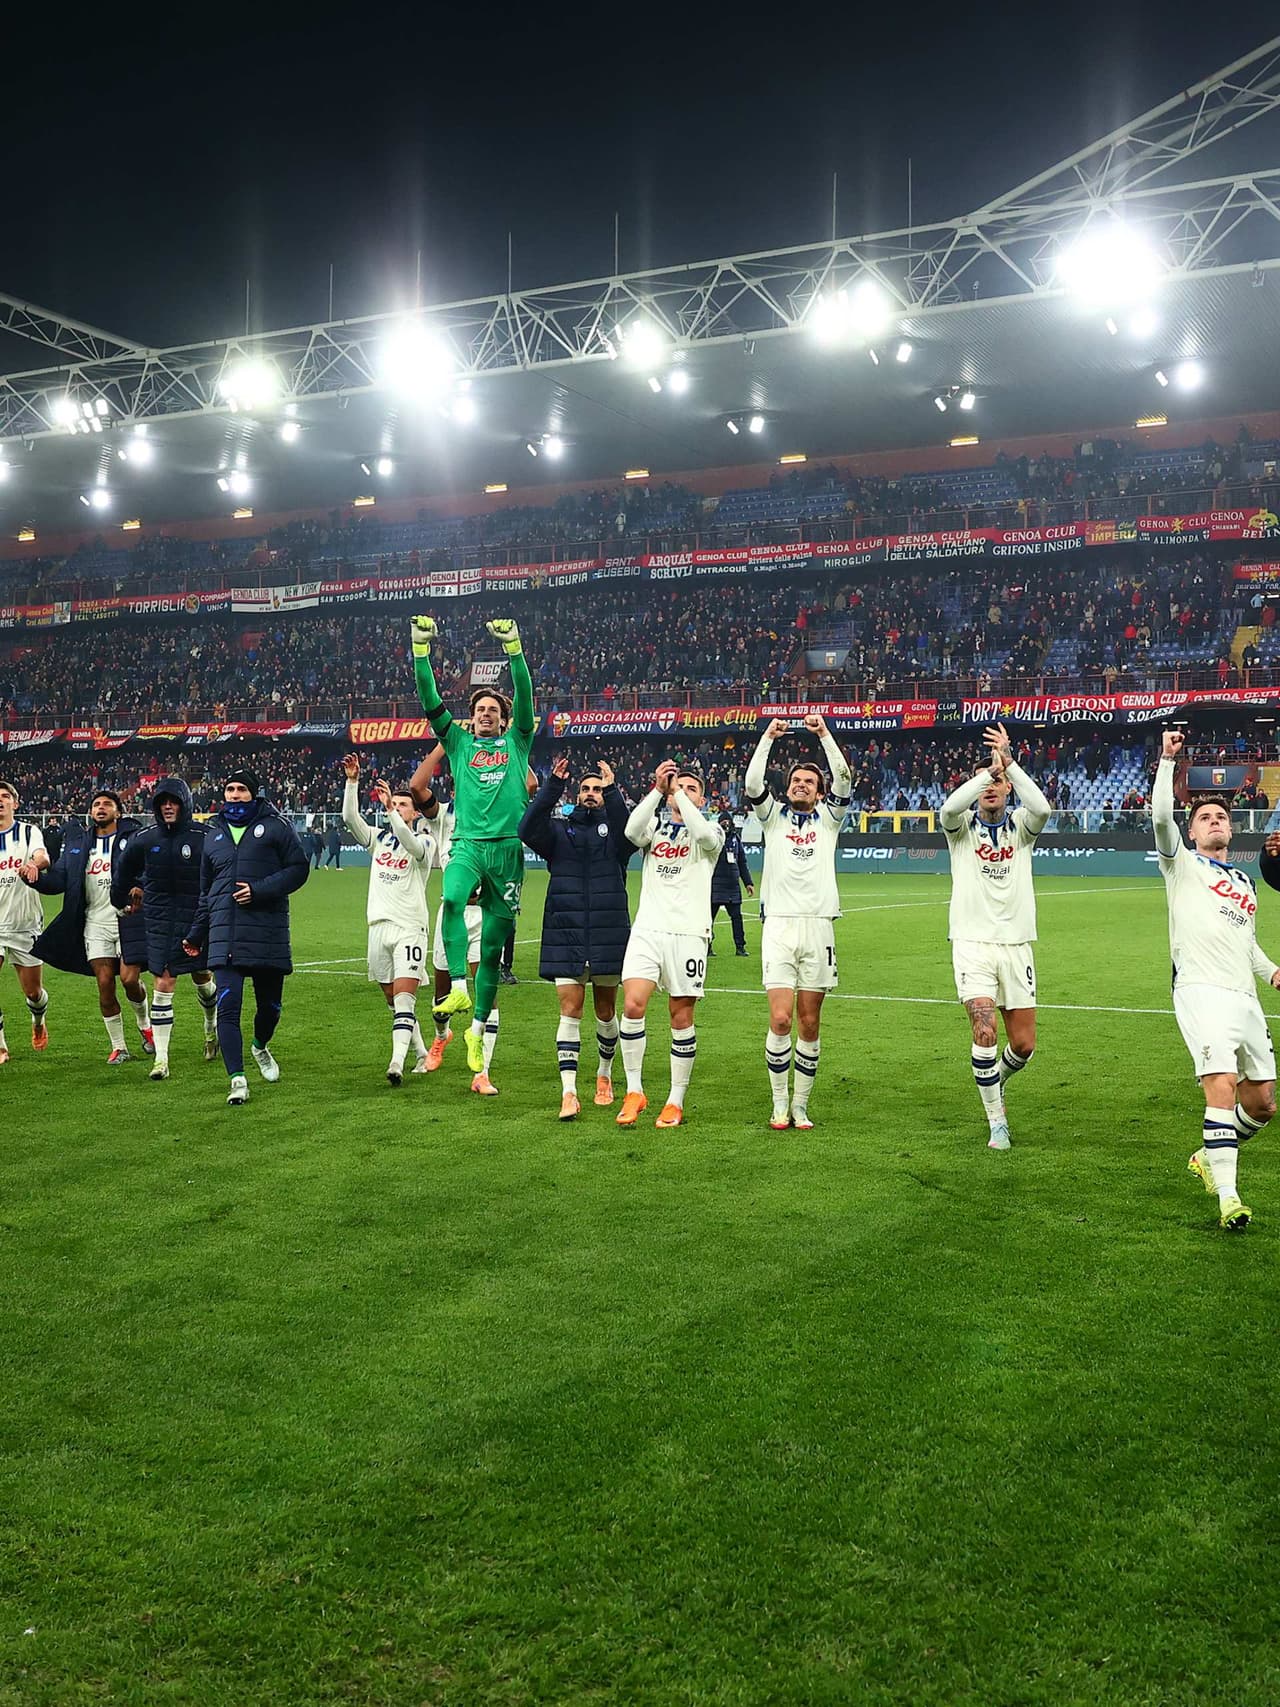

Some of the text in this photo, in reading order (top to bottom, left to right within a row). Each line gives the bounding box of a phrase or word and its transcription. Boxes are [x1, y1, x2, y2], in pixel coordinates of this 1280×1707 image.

[1139, 517, 1209, 529] GENOA CLU
[1210, 512, 1245, 521] GENOA
[898, 531, 971, 545] GENOA CLUB
[1002, 525, 1077, 544] GENOA CLUB
[1091, 530, 1137, 542] IMPERIA
[1153, 535, 1200, 545] ALIMONDA
[750, 543, 811, 555] GENOA CLUB
[816, 539, 883, 554] GENOA CLUB
[893, 537, 986, 552] ISTITUTO ITALIANO
[992, 537, 1083, 556] GRIFONE INSIDE
[648, 553, 693, 567] ARQUAT
[696, 551, 749, 562] GENOA CLUB
[890, 545, 985, 561] DELLA SALDATURA
[550, 560, 594, 573] DIPENDENTI
[824, 555, 872, 568] MIROGLIO
[431, 568, 482, 582] GENOA CLU
[485, 567, 529, 577] GENOA CLUB
[597, 566, 641, 579] EUSEBIO
[696, 565, 748, 575] ENTRACQUE
[320, 579, 369, 592] GENOA CLUB
[378, 576, 431, 590] GENOA CLUB
[485, 578, 528, 591] REGIONE
[549, 572, 588, 587] LIGURIA
[232, 589, 253, 600] GENOA
[284, 582, 320, 598] NEW YORK
[320, 590, 368, 604] SAN TEODORO
[378, 589, 413, 601] RAPALLO
[206, 602, 228, 612] UNICA
[911, 702, 957, 711] GENOA CLUB
[1051, 697, 1117, 714] GRIFONI
[1121, 692, 1188, 707] GENOA CLUB
[761, 704, 830, 716] GENOA CLUB GAVI
[832, 704, 903, 715] GENOA CLUB
[1126, 705, 1177, 724] S.OLCESE
[573, 711, 660, 723] ASSOCIAZIONE
[681, 710, 721, 729] Little
[723, 709, 758, 726] Club
[835, 718, 898, 730] VALBORMIDA
[1052, 710, 1114, 726] TORINO
[350, 721, 398, 743] FIGGI
[570, 722, 653, 735] CLUB GENOANI
[8, 731, 33, 742] GENOA
[469, 749, 509, 767] Lete
[651, 842, 690, 859] Lete
[975, 842, 1014, 863] Lete
[0, 858, 22, 871] ete
[86, 858, 111, 875] Le
[375, 851, 409, 871] Lete
[1209, 880, 1257, 917] Lete
[404, 945, 423, 962] 10
[685, 958, 704, 978] 90
[1026, 965, 1034, 986] 9
[797, 1057, 817, 1068] DEA
